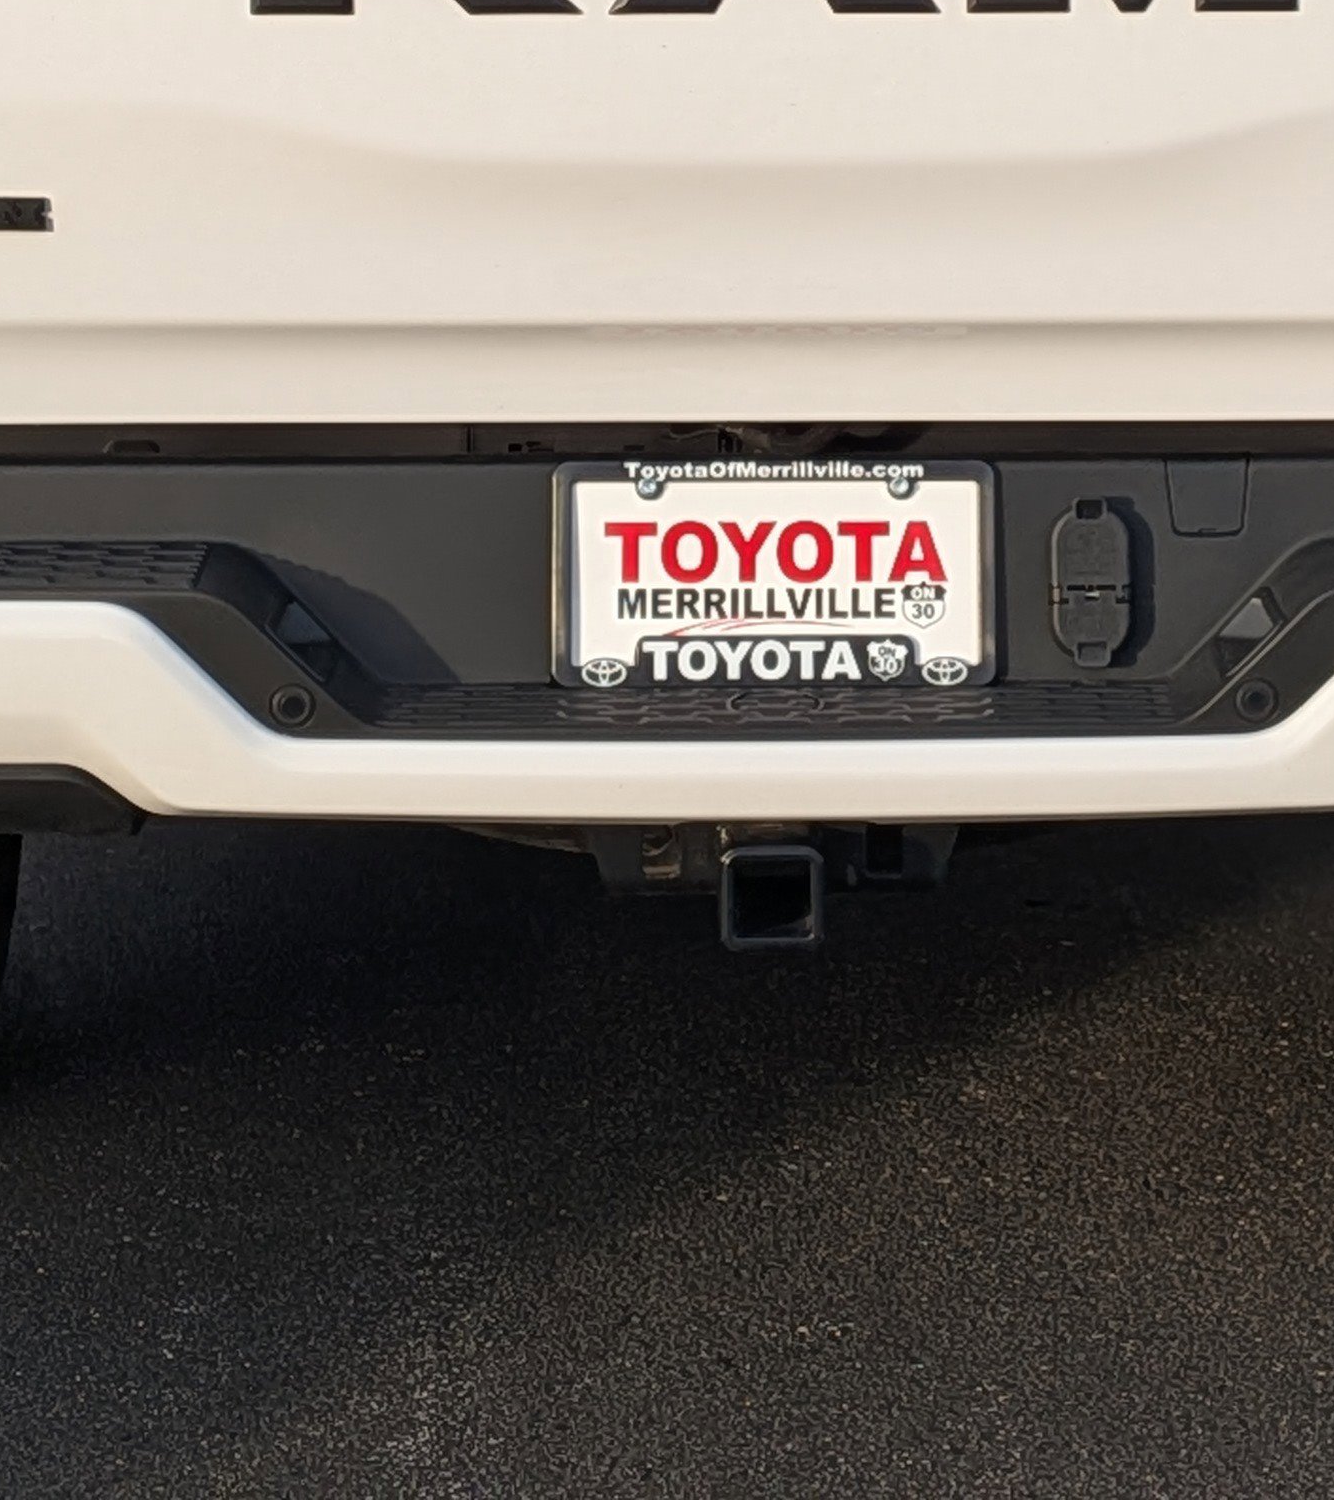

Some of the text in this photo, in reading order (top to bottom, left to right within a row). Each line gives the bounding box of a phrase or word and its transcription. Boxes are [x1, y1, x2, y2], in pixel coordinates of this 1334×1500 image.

[623, 461, 925, 482] ToyotaOfMerrillville.com
[604, 520, 948, 584] TOYOTA
[617, 587, 897, 620] MERRILLVILLE
[909, 586, 936, 600] ON
[911, 603, 936, 620] 30
[642, 640, 863, 682] TOYOTA
[871, 655, 899, 674] 30
